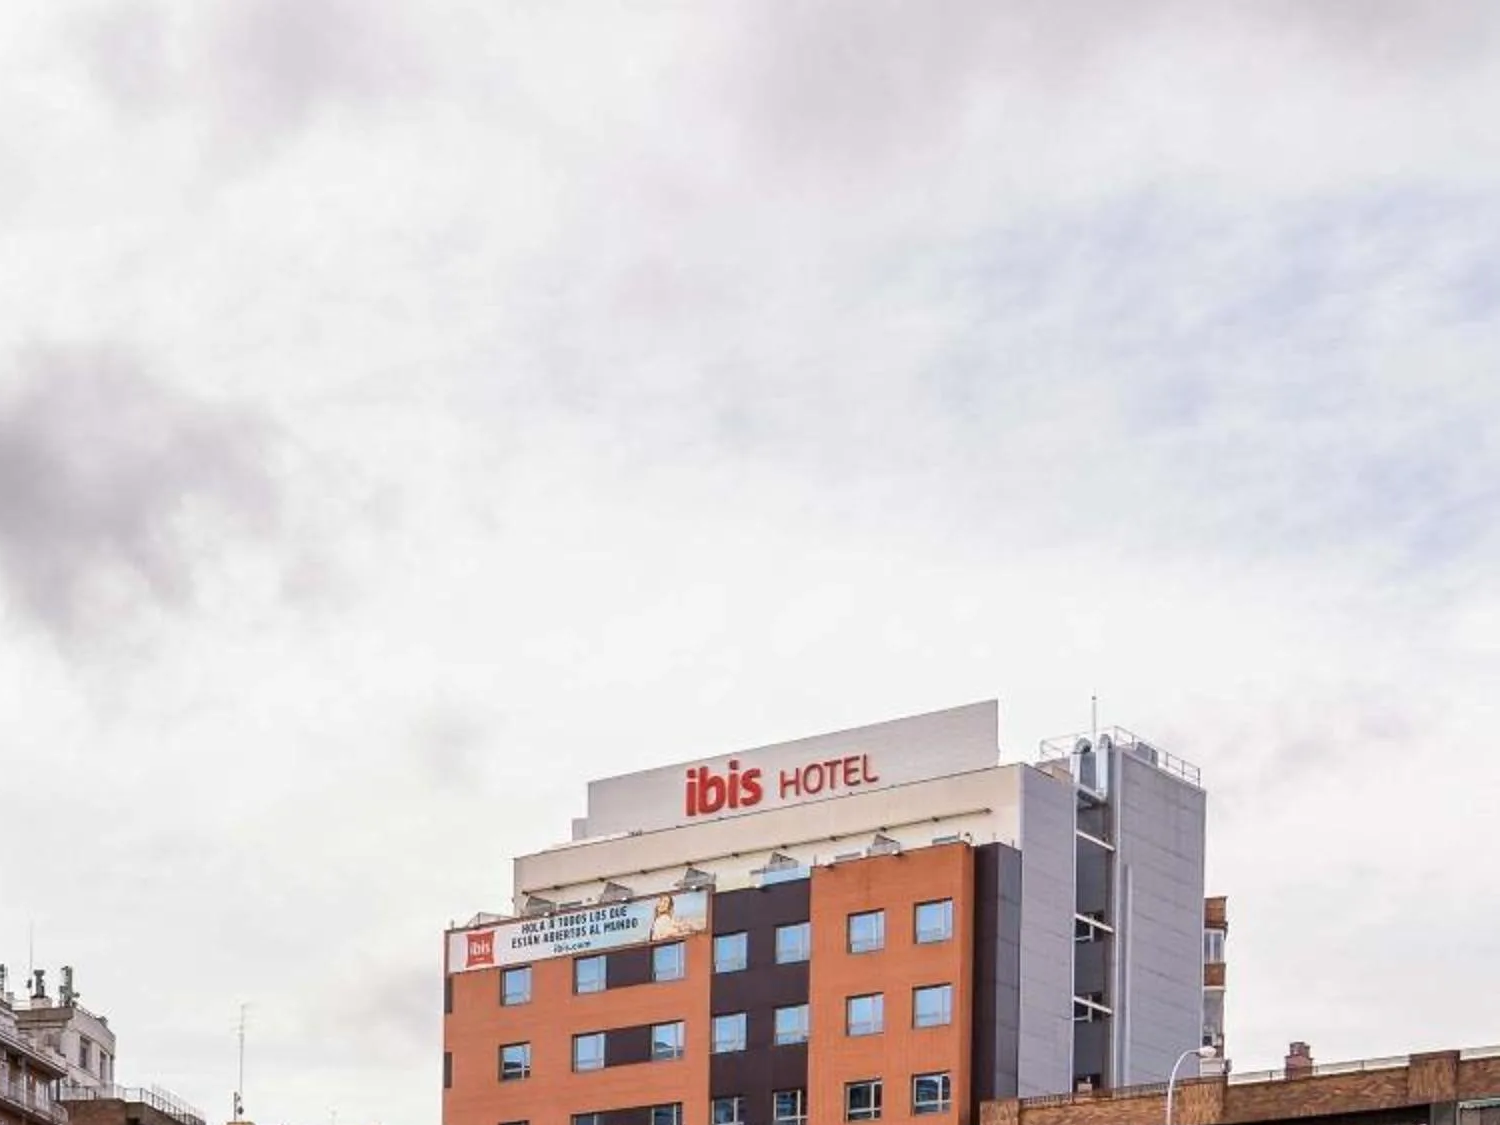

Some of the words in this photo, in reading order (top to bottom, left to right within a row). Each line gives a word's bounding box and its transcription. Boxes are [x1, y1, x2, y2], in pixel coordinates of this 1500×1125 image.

[685, 760, 763, 817] ibis
[779, 753, 880, 799] HOTEL
[469, 939, 491, 956] ibis
